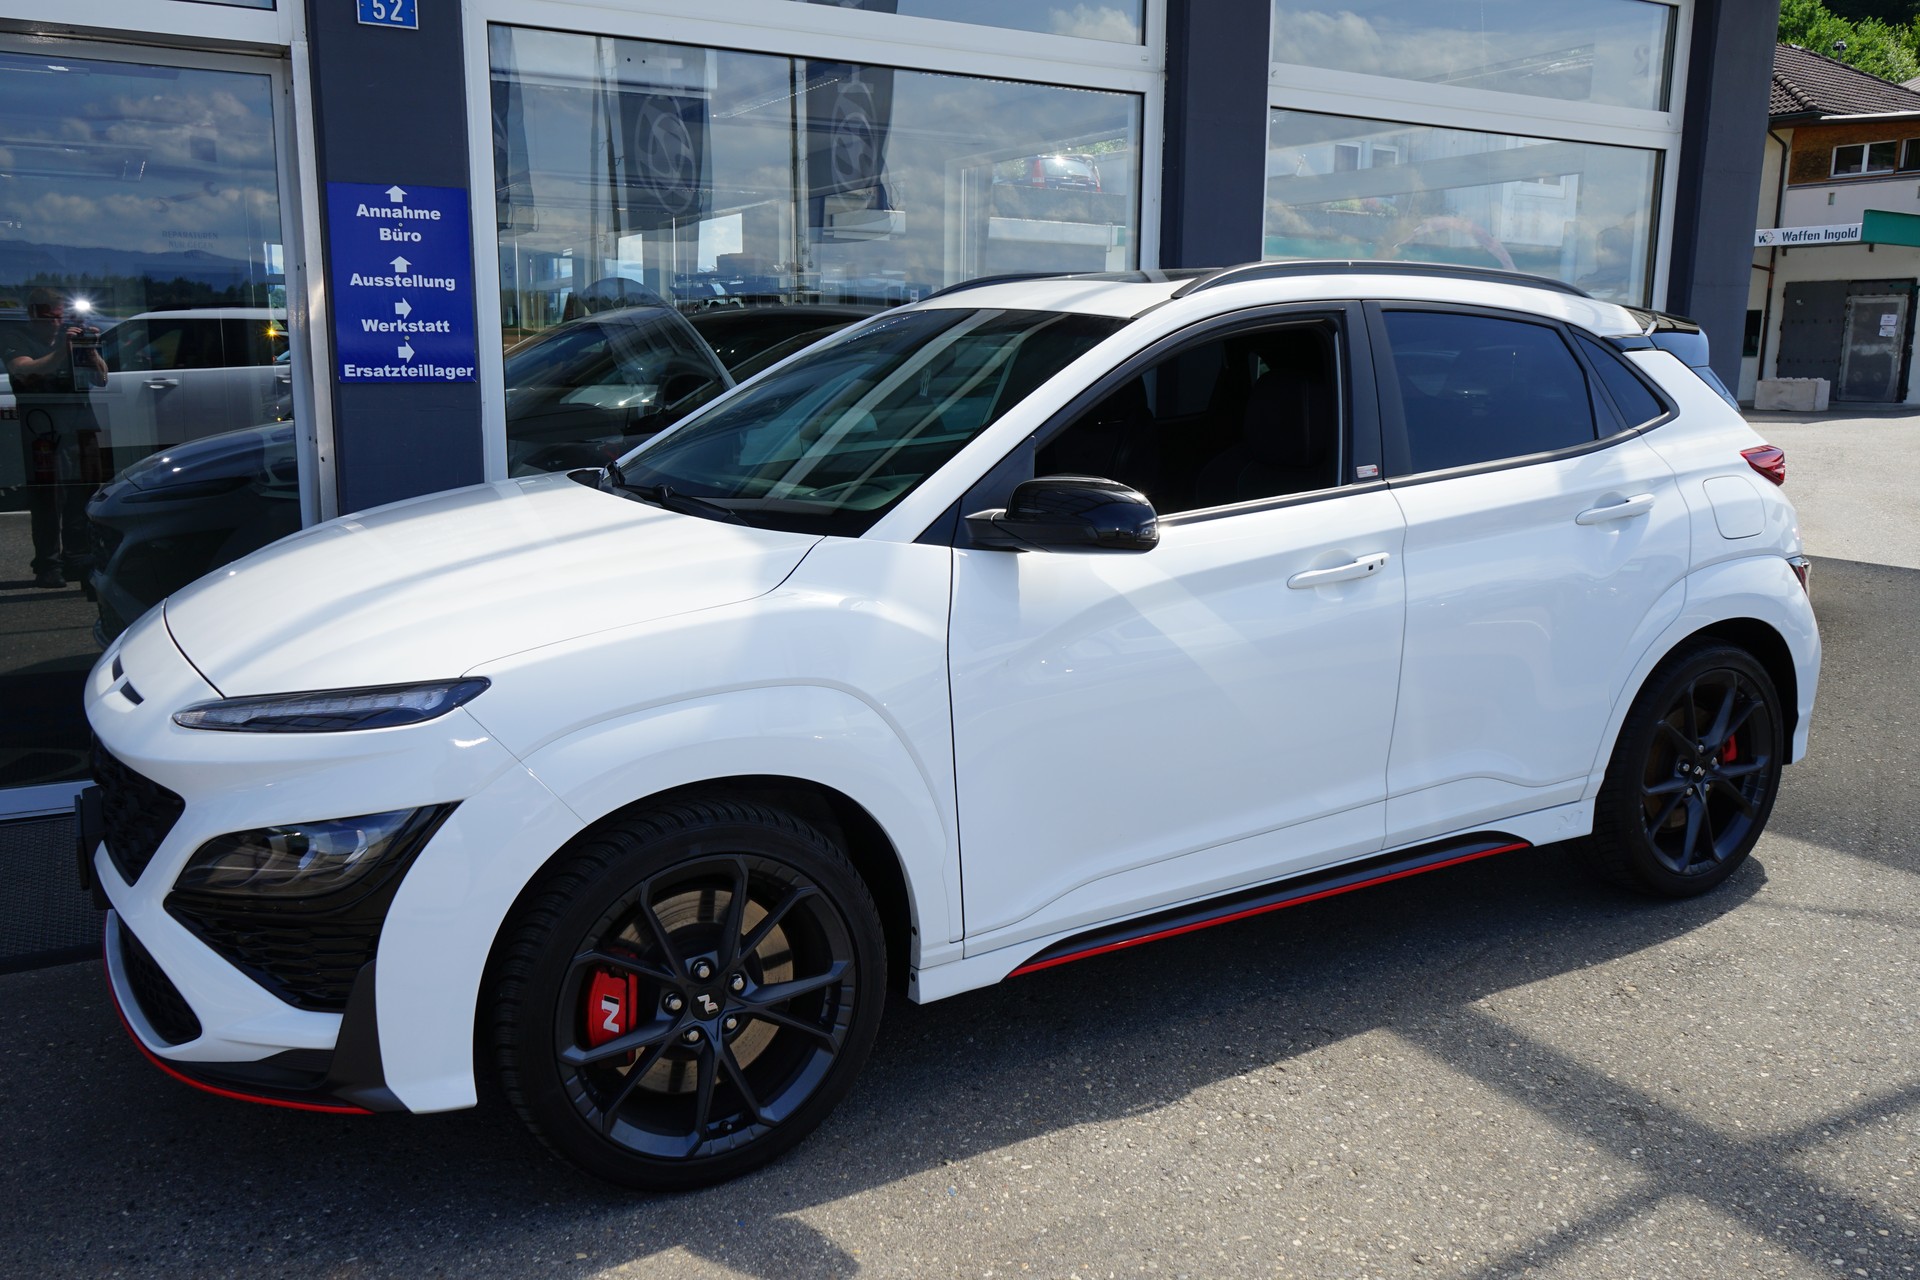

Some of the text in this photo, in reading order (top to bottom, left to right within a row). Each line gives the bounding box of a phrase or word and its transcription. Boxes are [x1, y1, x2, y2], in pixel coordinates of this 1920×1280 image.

[372, 0, 404, 21] 52
[356, 204, 441, 220] Annahme
[379, 227, 422, 242] Büro
[1782, 230, 1820, 242] Waffen
[1824, 227, 1858, 241] Ingold
[350, 273, 456, 291] Ausstellung
[361, 319, 450, 333] Werkstatt
[344, 364, 474, 380] Ersatzteillager
